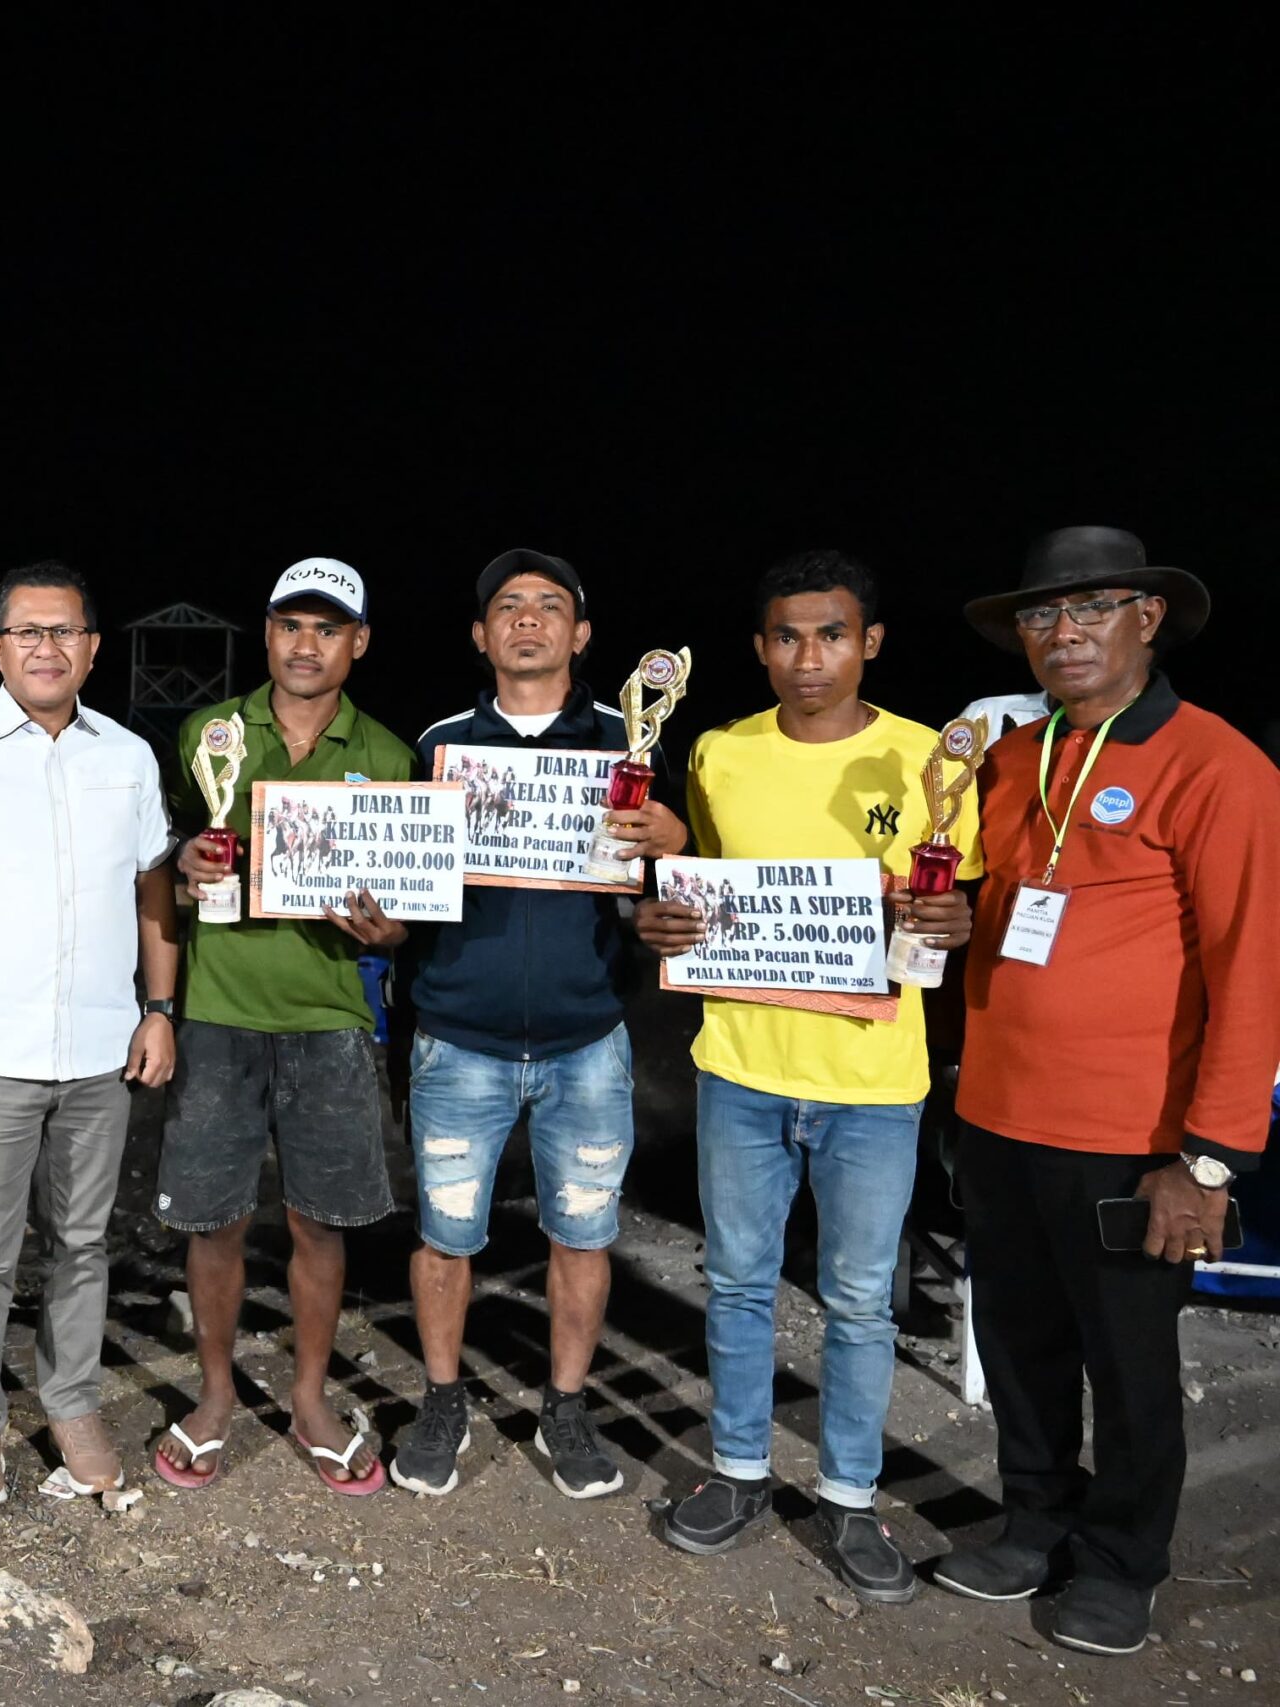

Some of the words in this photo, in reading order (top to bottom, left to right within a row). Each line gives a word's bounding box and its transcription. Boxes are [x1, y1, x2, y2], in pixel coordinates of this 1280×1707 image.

[534, 756, 589, 778] JUARA
[595, 759, 611, 779] II
[504, 781, 557, 803] KELAS
[562, 785, 574, 805] A
[350, 794, 404, 816] JUARA
[410, 796, 432, 815] III
[508, 810, 538, 829] RP.
[864, 803, 901, 836] NY
[325, 821, 378, 842] KELAS
[383, 823, 395, 843] A
[400, 823, 455, 845] SUPER
[474, 832, 518, 849] Lomba
[523, 836, 573, 853] Pacuan
[330, 848, 360, 868] RP.
[366, 850, 455, 871] 3.000.000
[464, 852, 490, 867] IALA
[494, 854, 549, 871] KAPOLDA
[553, 859, 574, 873] CUP
[297, 873, 342, 889] Lomba
[346, 875, 396, 892] Pacuan
[400, 876, 434, 893] Kuda
[756, 866, 818, 889] JUARA
[824, 866, 834, 887] I
[282, 894, 315, 908] PIALA
[402, 901, 427, 912] TAHUN
[429, 902, 450, 912] 2025
[723, 895, 783, 915] KELAS
[789, 896, 803, 915] A
[809, 896, 873, 917] SUPER
[734, 922, 768, 942] RP.
[773, 923, 877, 945] 5.000.000
[701, 948, 751, 962] Lomba
[755, 949, 811, 964] Pacuan
[815, 950, 854, 966] Kuda
[687, 966, 724, 980] PIALA
[727, 967, 787, 983] KAPOLDA
[791, 969, 816, 984] CUP
[819, 974, 849, 987] TAHUN
[850, 976, 875, 988] 2025
